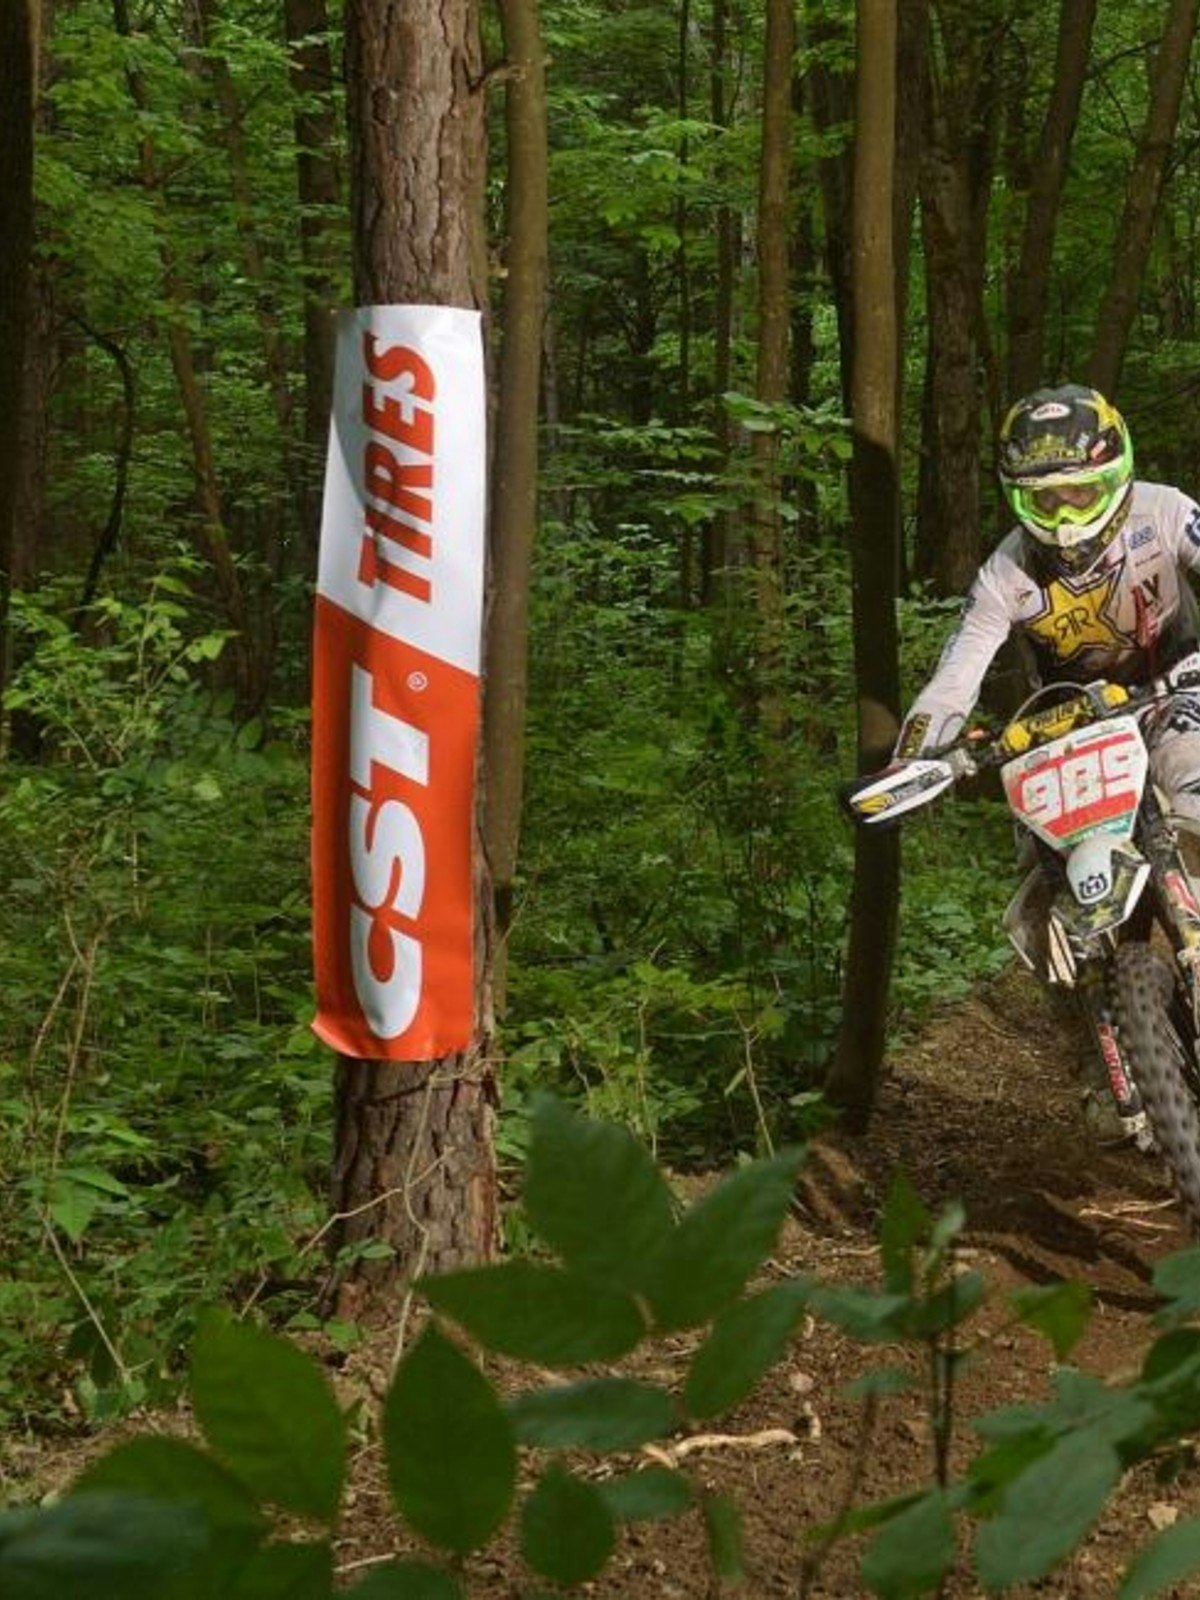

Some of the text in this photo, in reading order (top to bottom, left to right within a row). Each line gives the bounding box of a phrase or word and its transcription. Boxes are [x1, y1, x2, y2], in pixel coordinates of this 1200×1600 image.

[358, 331, 435, 604] TIRES
[350, 663, 429, 1040] CST
[1021, 741, 1137, 824] 989
